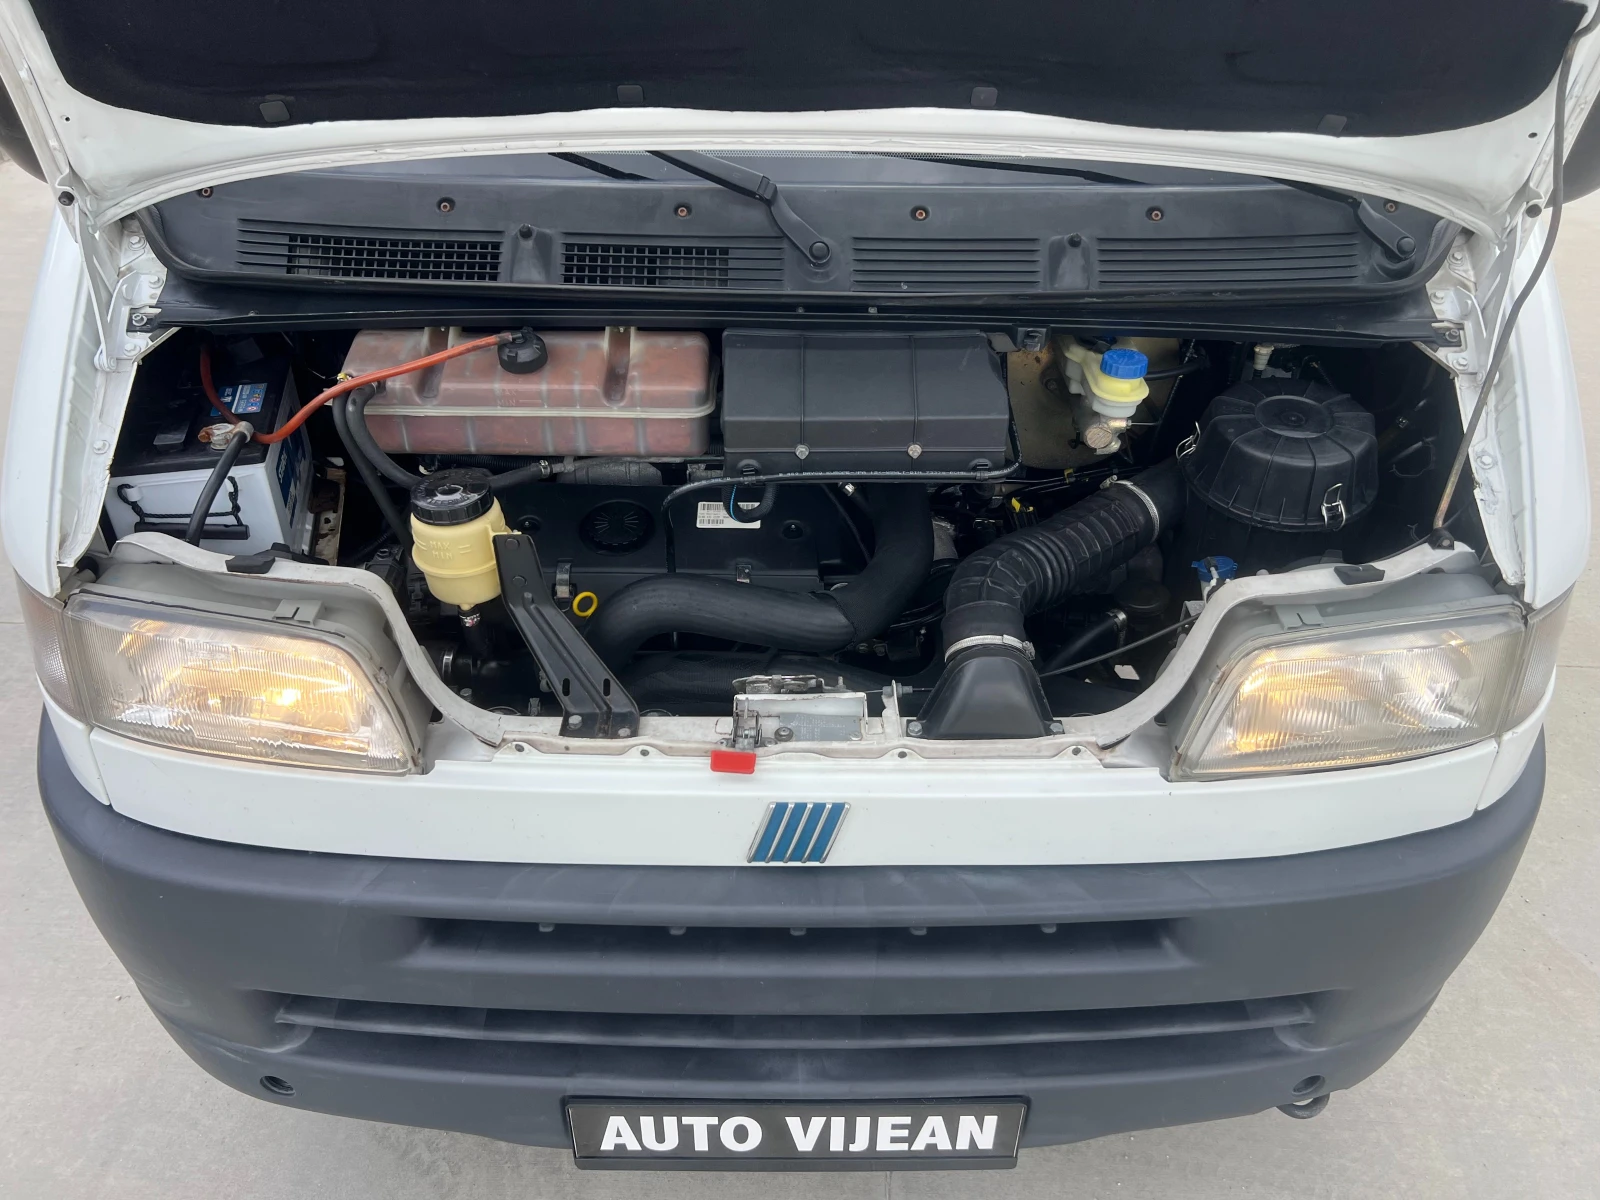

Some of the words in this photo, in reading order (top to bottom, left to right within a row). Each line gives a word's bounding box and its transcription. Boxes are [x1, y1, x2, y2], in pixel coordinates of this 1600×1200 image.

[429, 541, 450, 550] MAX
[432, 550, 453, 560] MIN
[600, 1115, 763, 1152] AUTO
[785, 1115, 998, 1152] VIJEAN
